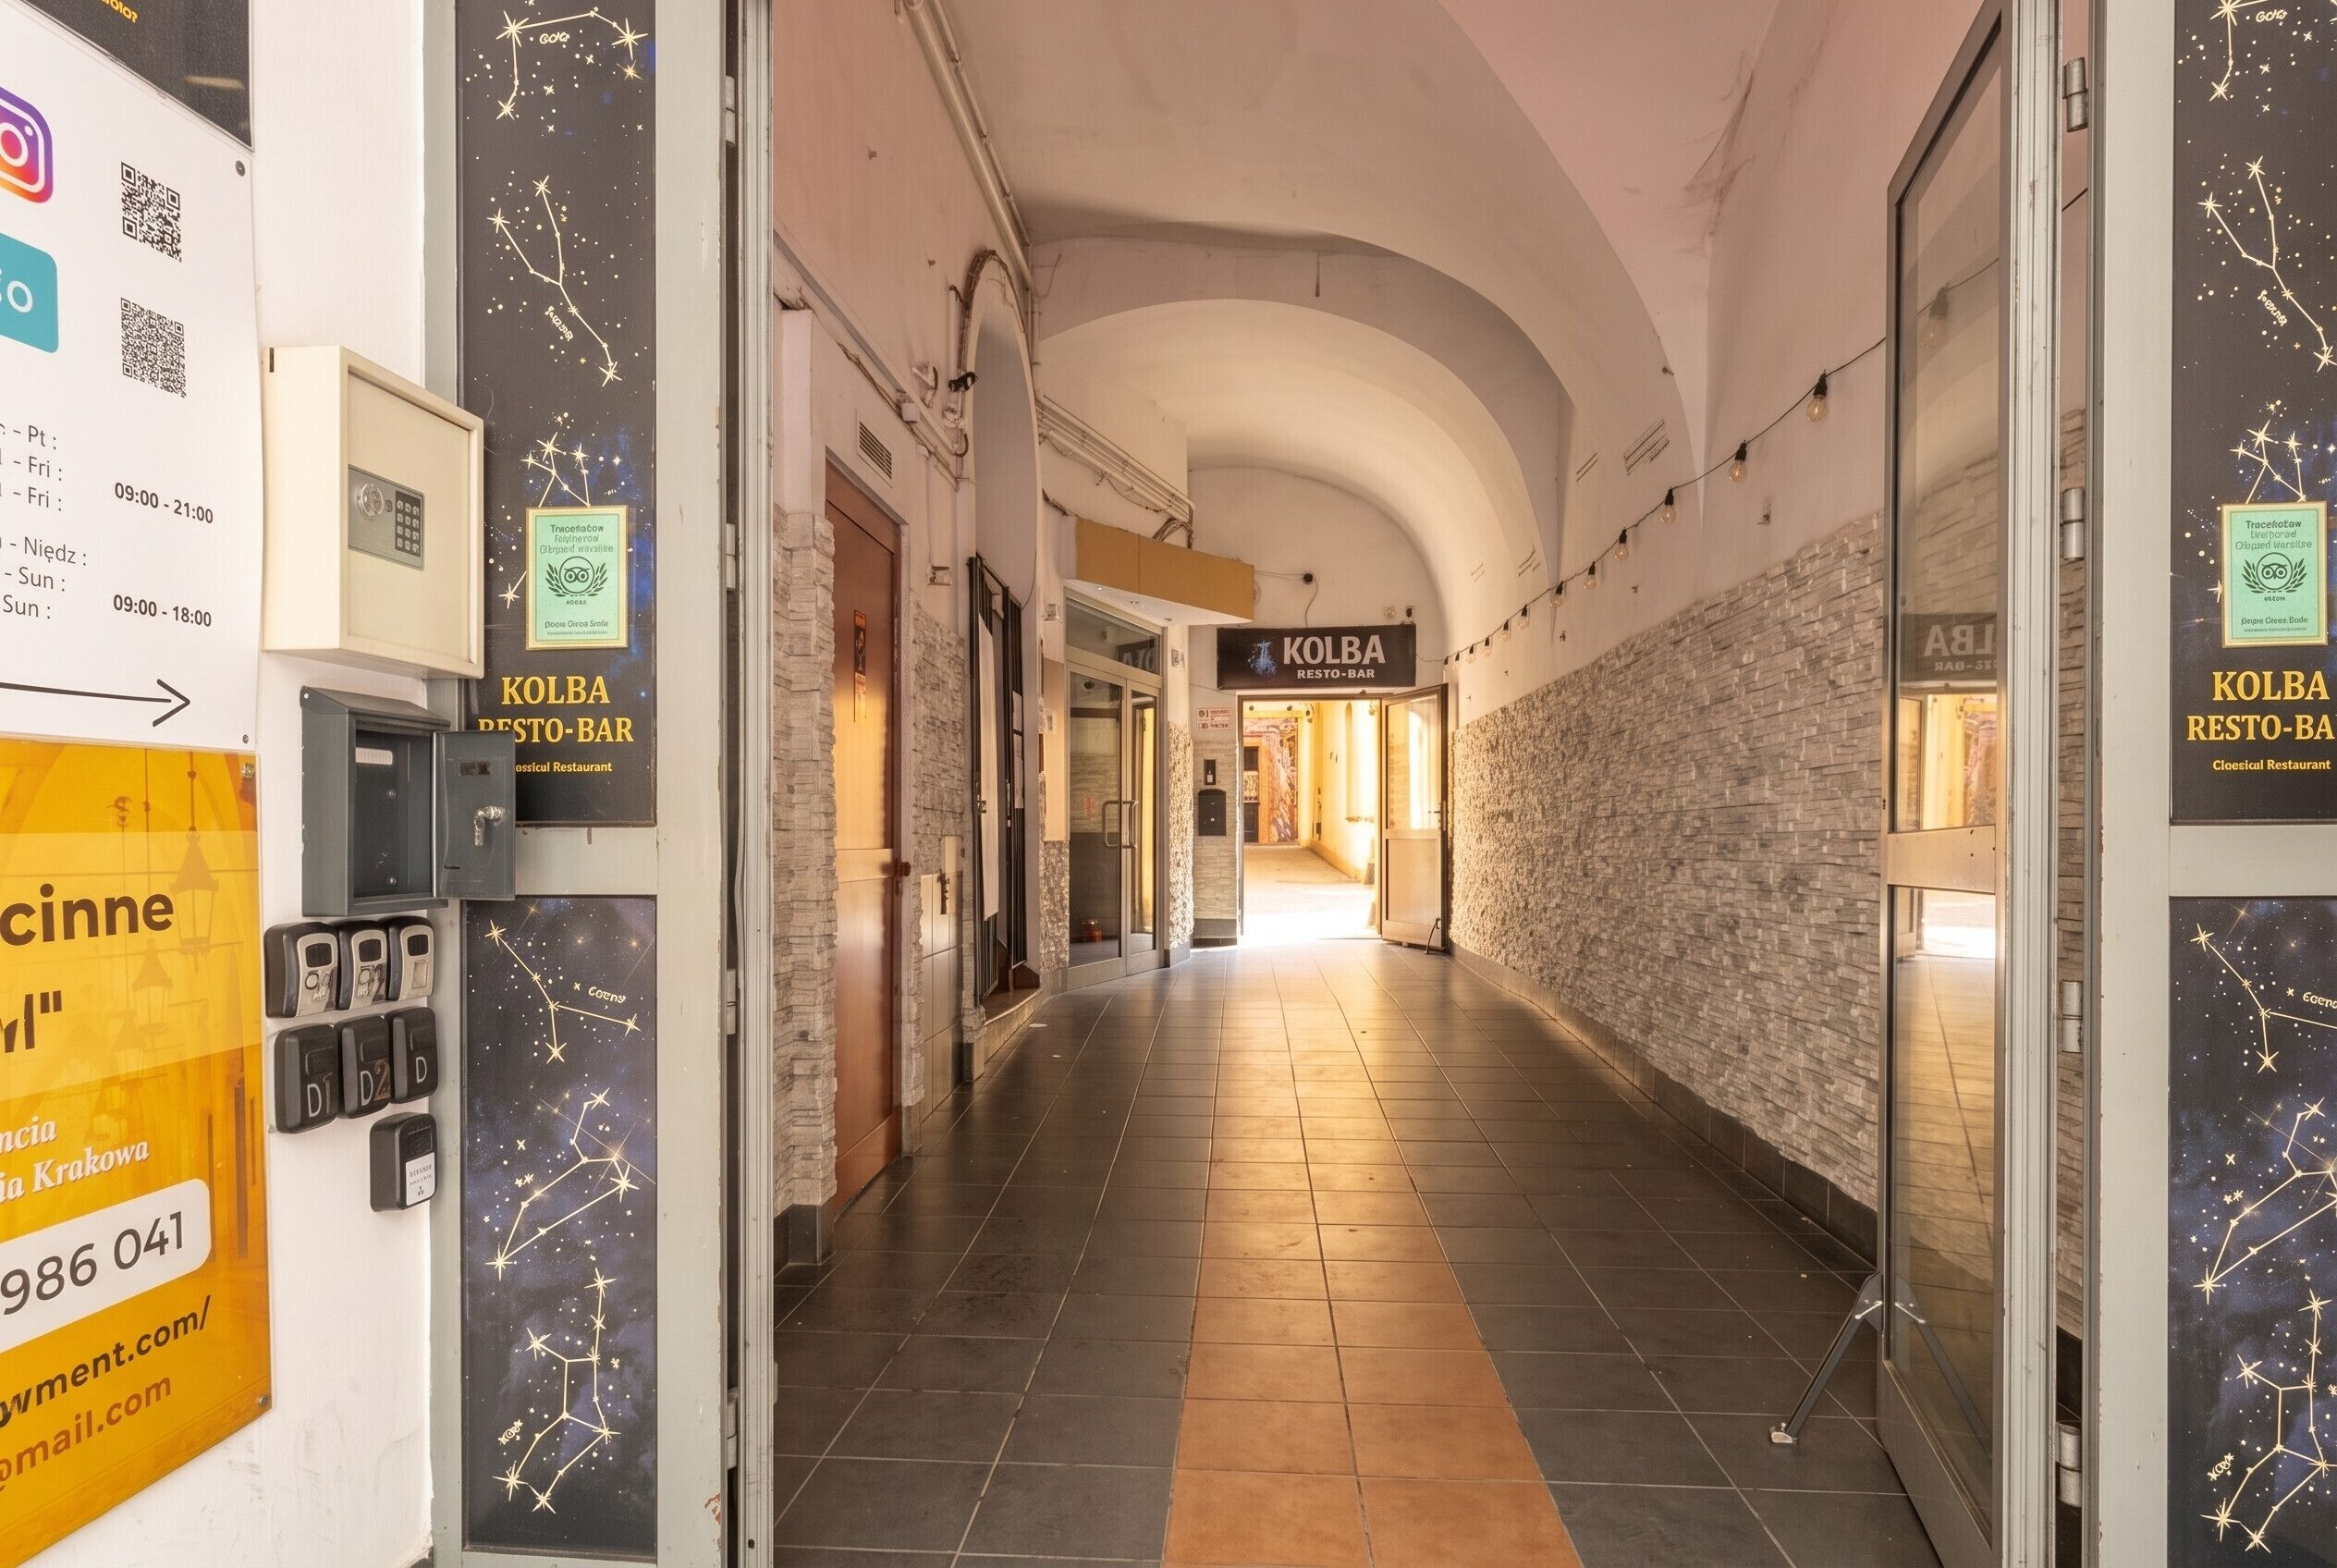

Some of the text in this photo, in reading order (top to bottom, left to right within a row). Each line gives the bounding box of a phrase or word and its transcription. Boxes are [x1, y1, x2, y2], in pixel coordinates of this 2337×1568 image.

[29, 424, 46, 447] Pt
[29, 456, 50, 478] Fri
[29, 486, 49, 508] Fri
[115, 482, 159, 508] 09:00
[174, 499, 214, 524] 21:00
[24, 536, 77, 564] Niędz
[18, 566, 54, 590] Sun
[3, 594, 39, 617] Sun
[113, 594, 157, 617] 09:00
[173, 606, 212, 627] 18:00
[1283, 634, 1386, 665] KOLBA
[1297, 668, 1376, 680] RESTO-BAR
[2212, 670, 2331, 701] KOLBA
[501, 676, 610, 704] KOLBA
[2187, 714, 2336, 741] RESTO-BA
[553, 762, 613, 772] Restaurant
[2267, 760, 2331, 770] Restaurant
[32, 1141, 149, 1193] Krakowa
[0, 1211, 183, 1316] 986 041
